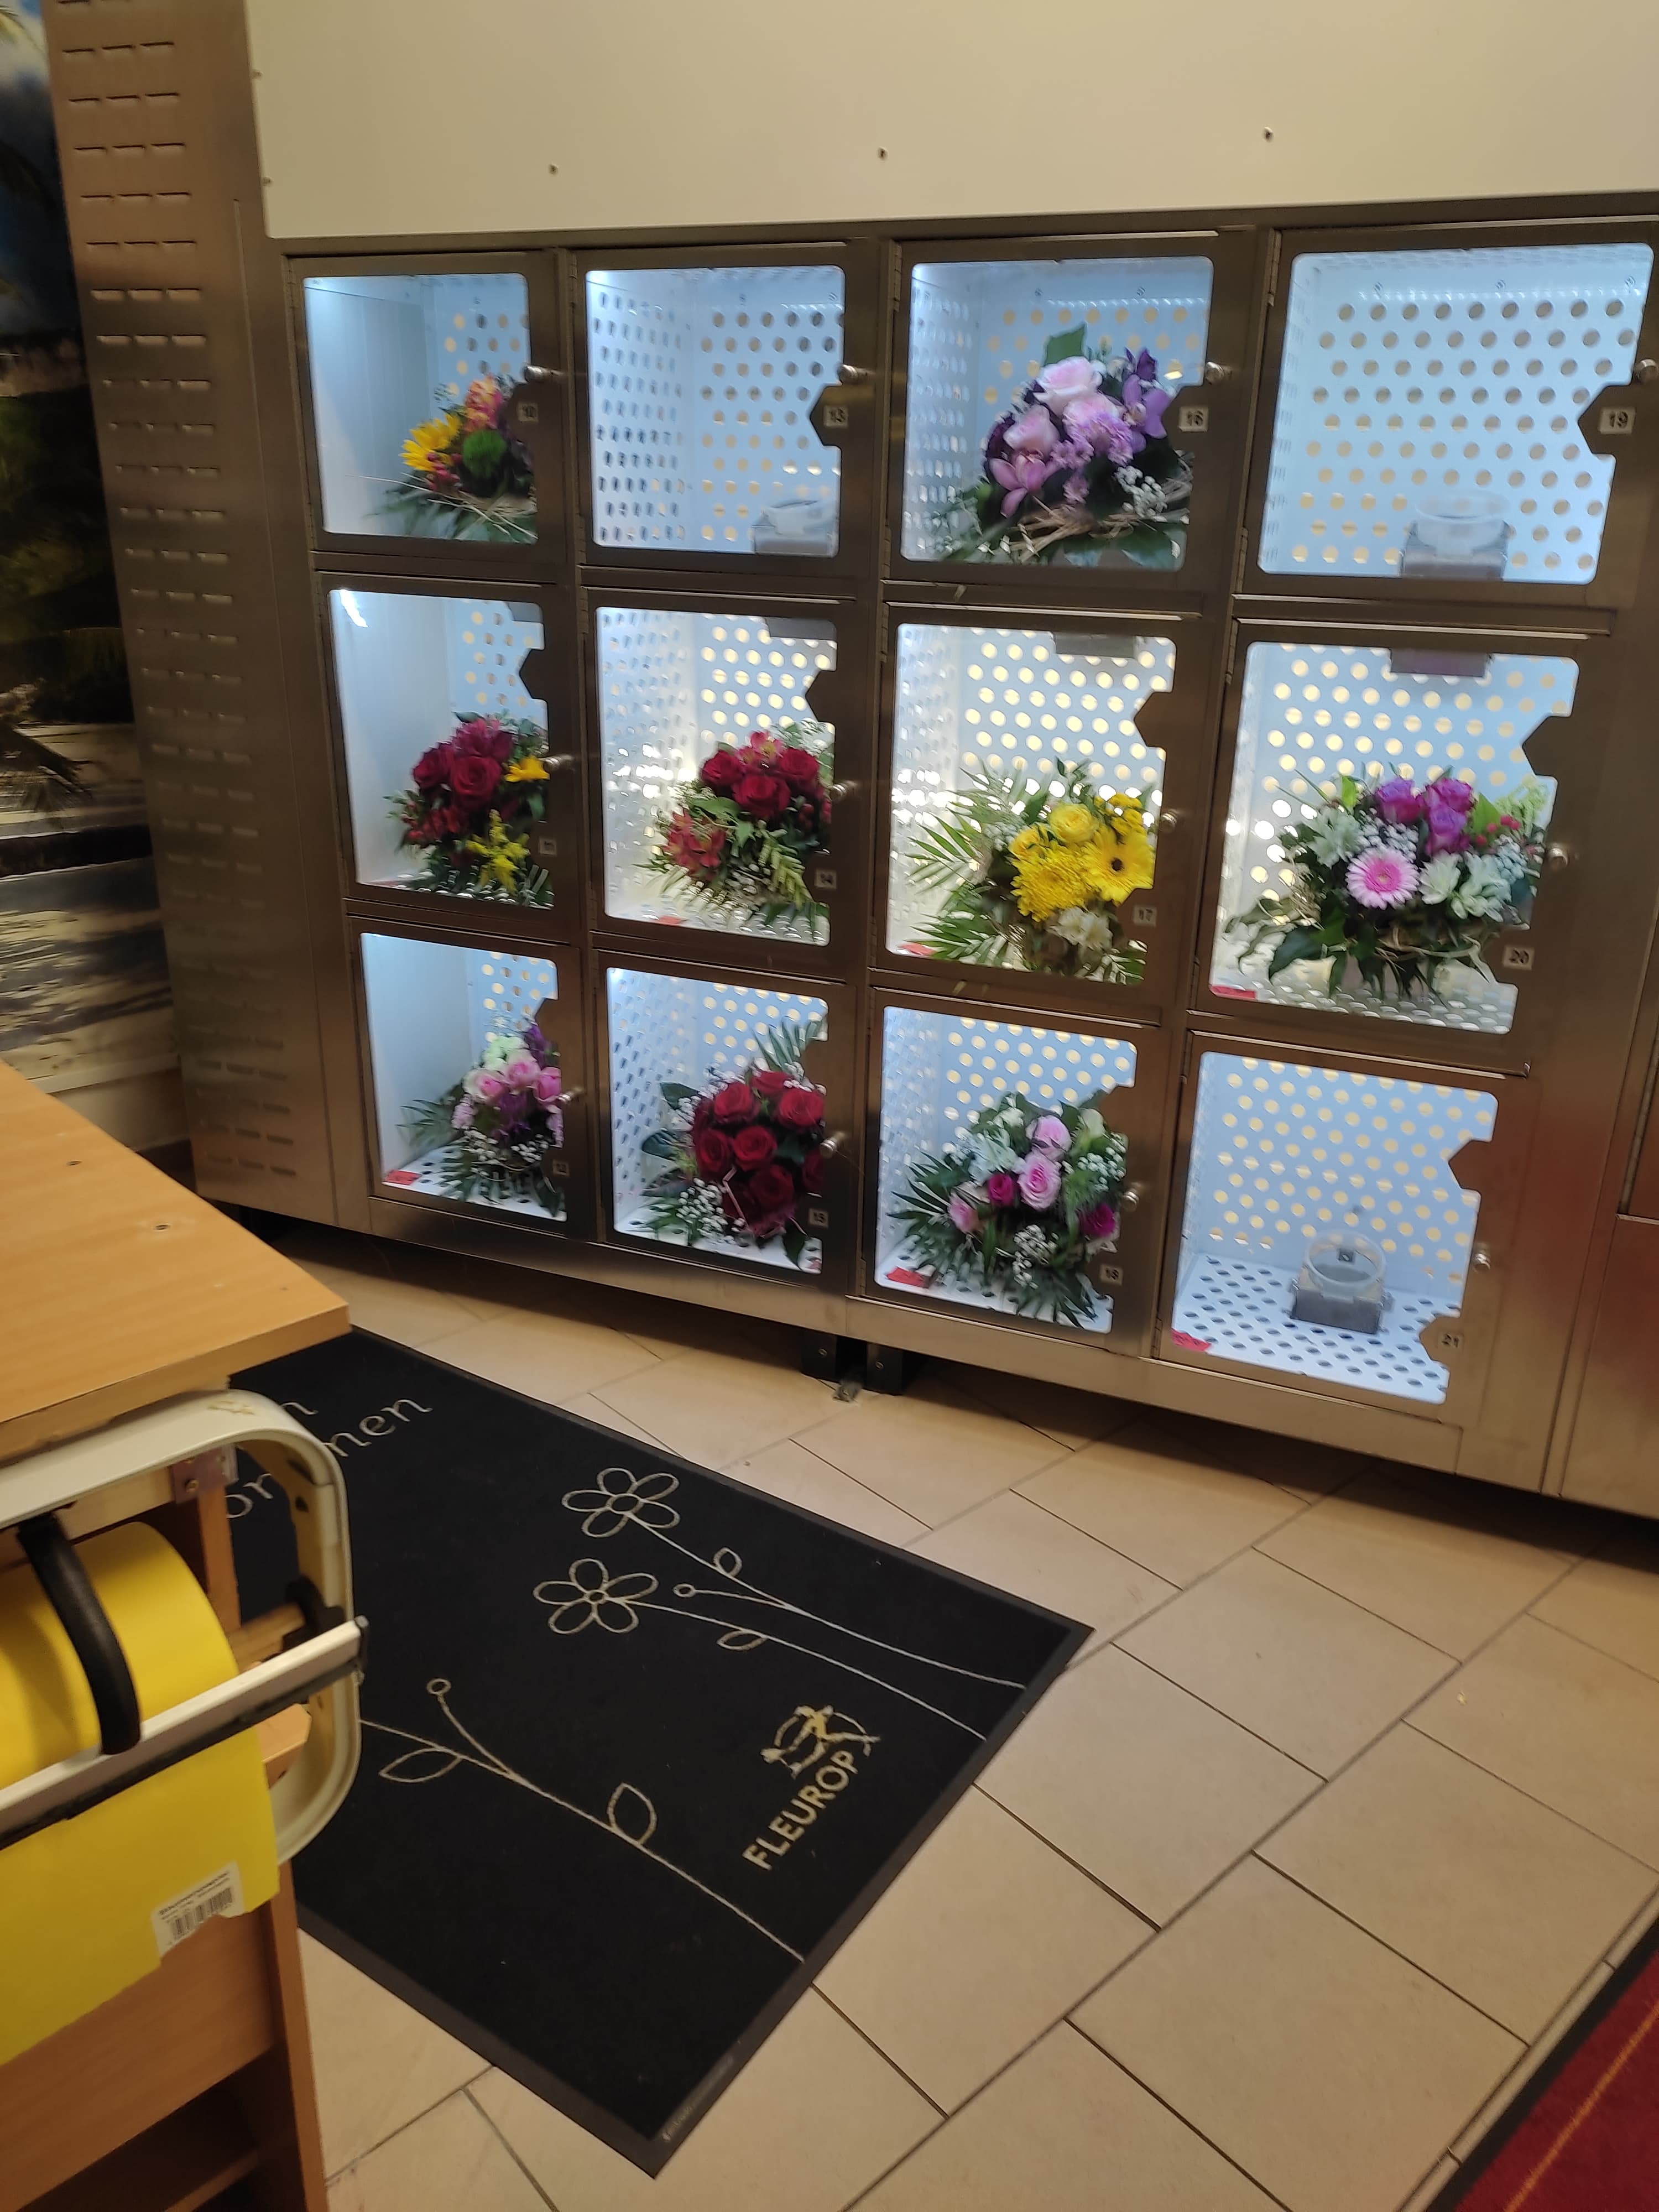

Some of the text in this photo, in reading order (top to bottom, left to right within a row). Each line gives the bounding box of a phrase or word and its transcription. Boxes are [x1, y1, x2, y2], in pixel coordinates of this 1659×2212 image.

[828, 408, 846, 422] 13
[1187, 411, 1204, 426] 16
[1608, 411, 1629, 429] 19
[1139, 909, 1153, 922] 17
[1509, 949, 1529, 964] 20
[1105, 1269, 1119, 1280] 18
[1442, 1333, 1459, 1348] 21
[742, 1749, 859, 1871] FLEUROP
